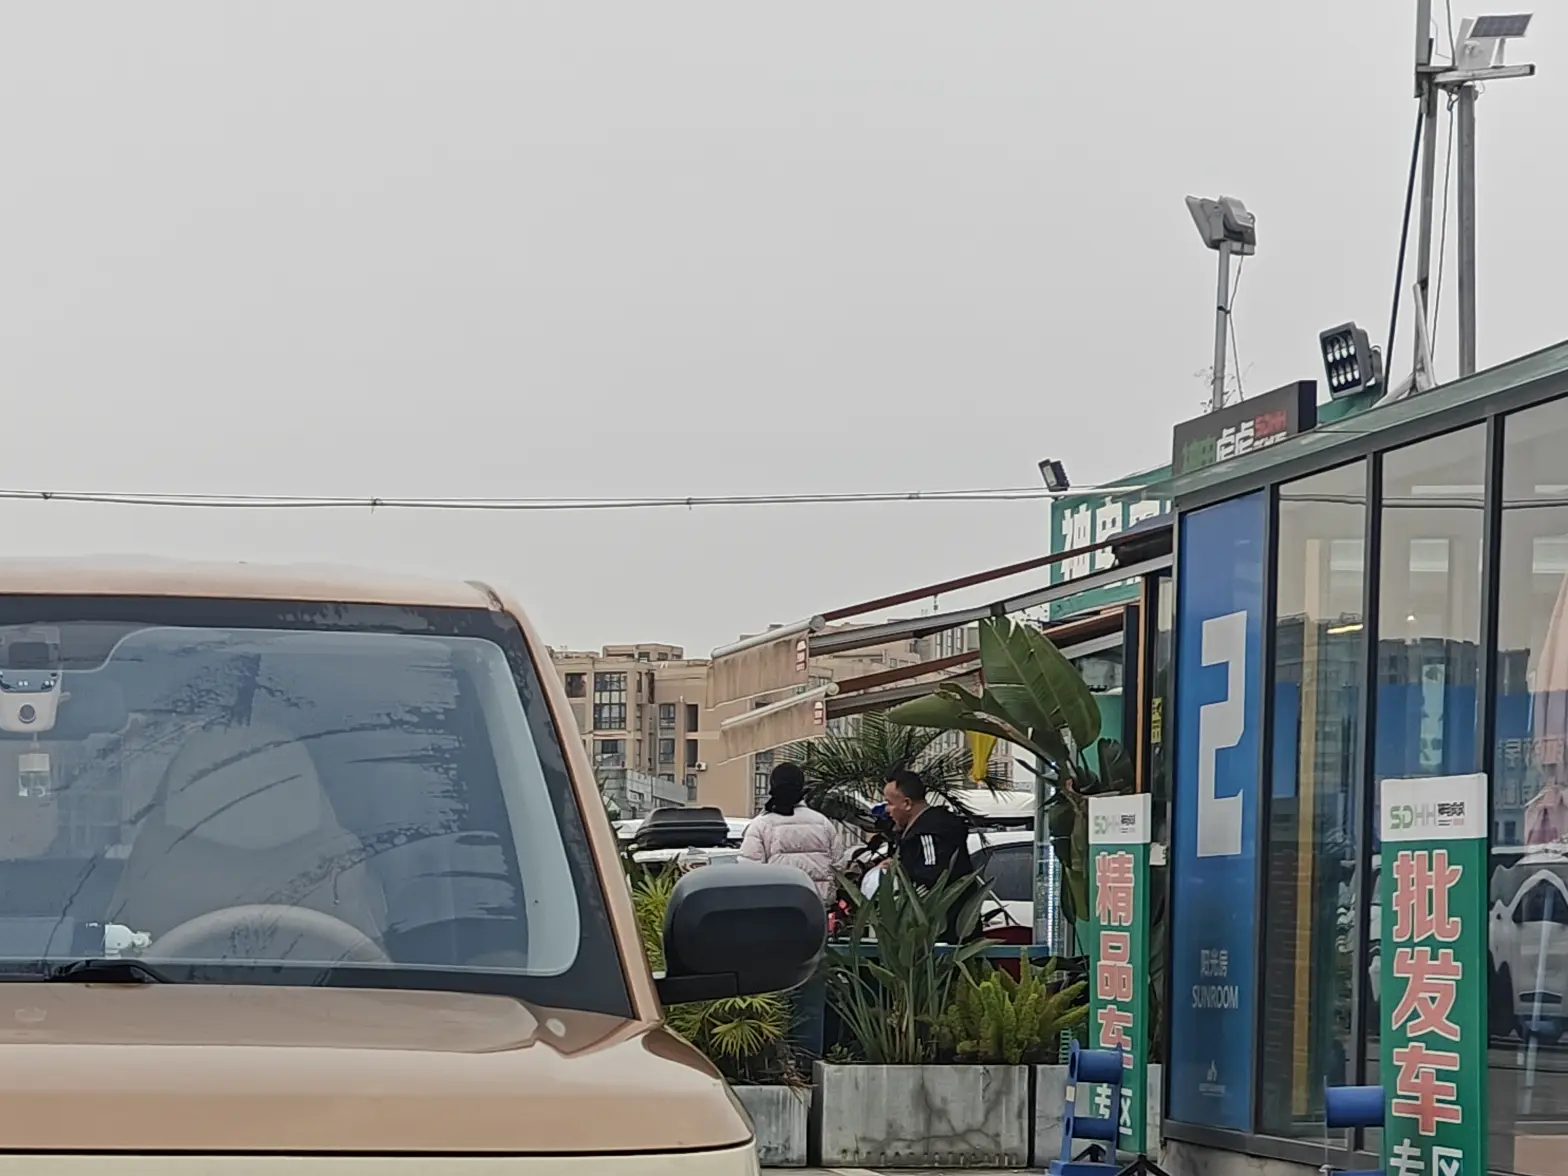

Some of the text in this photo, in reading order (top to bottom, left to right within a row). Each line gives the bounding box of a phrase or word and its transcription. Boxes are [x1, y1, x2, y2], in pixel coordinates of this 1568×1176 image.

[1197, 611, 1247, 857] 2
[1192, 985, 1239, 1009] SUNROOM
[1392, 850, 1463, 1136] 批发车
